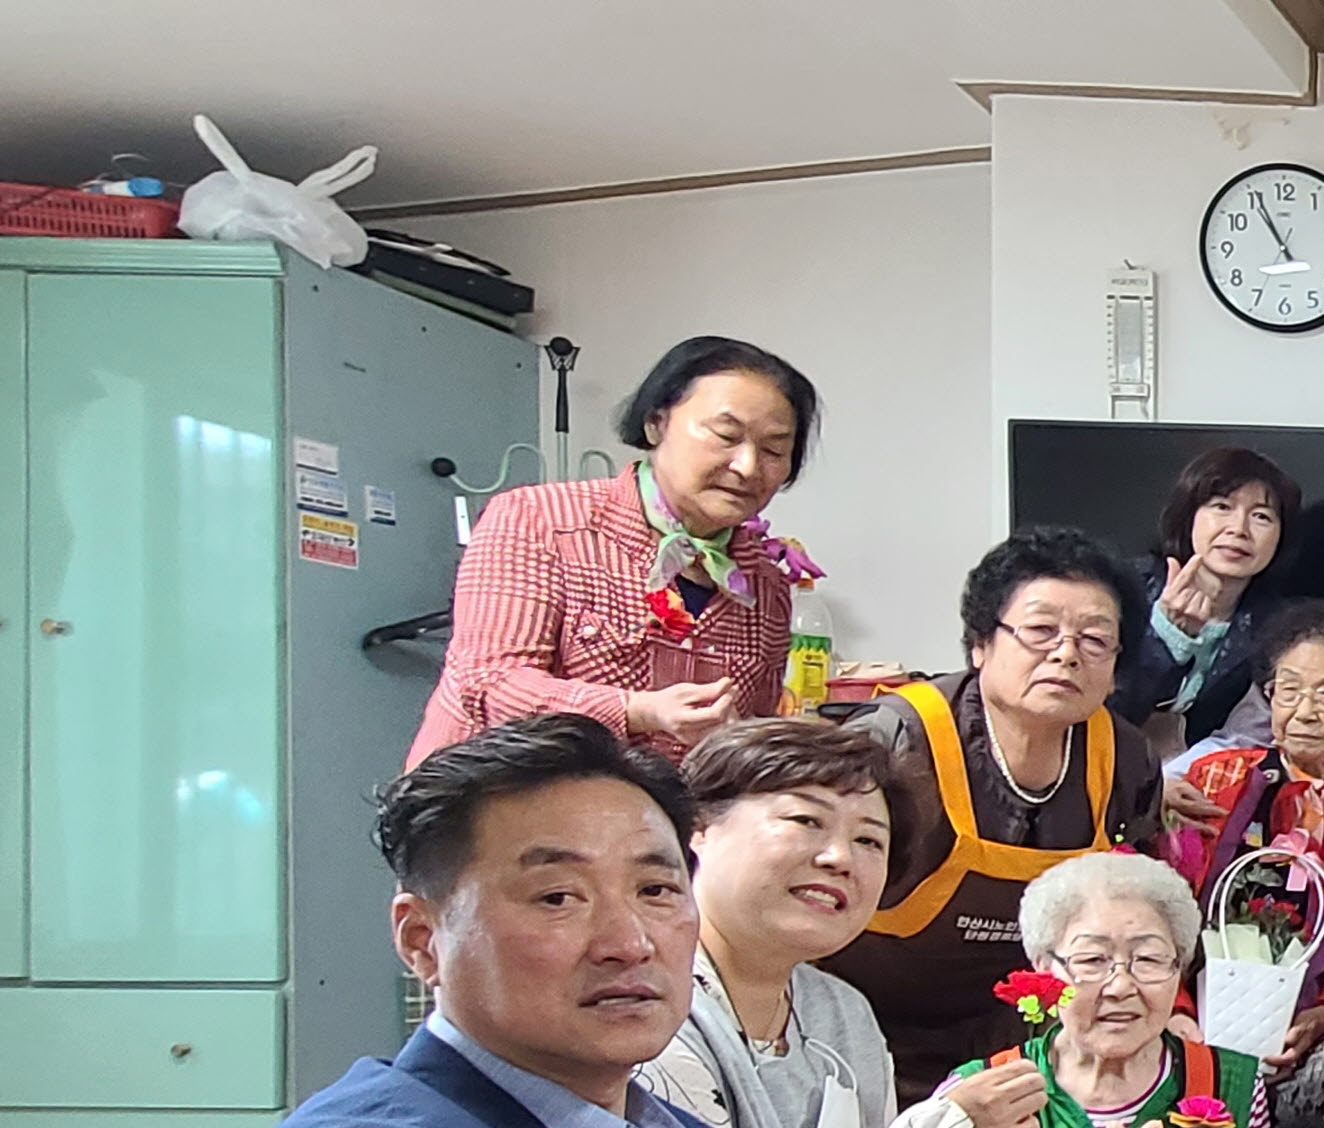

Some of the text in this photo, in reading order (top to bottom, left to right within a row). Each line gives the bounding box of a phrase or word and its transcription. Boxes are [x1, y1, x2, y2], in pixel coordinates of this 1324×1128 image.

[1274, 182, 1295, 201] 12
[1310, 192, 1318, 211] 1
[1227, 213, 1248, 232] 10
[1220, 241, 1234, 259] 9
[1230, 269, 1243, 287] 8
[1251, 289, 1263, 307] 7
[1278, 297, 1292, 315] 6
[1307, 290, 1319, 309] 5
